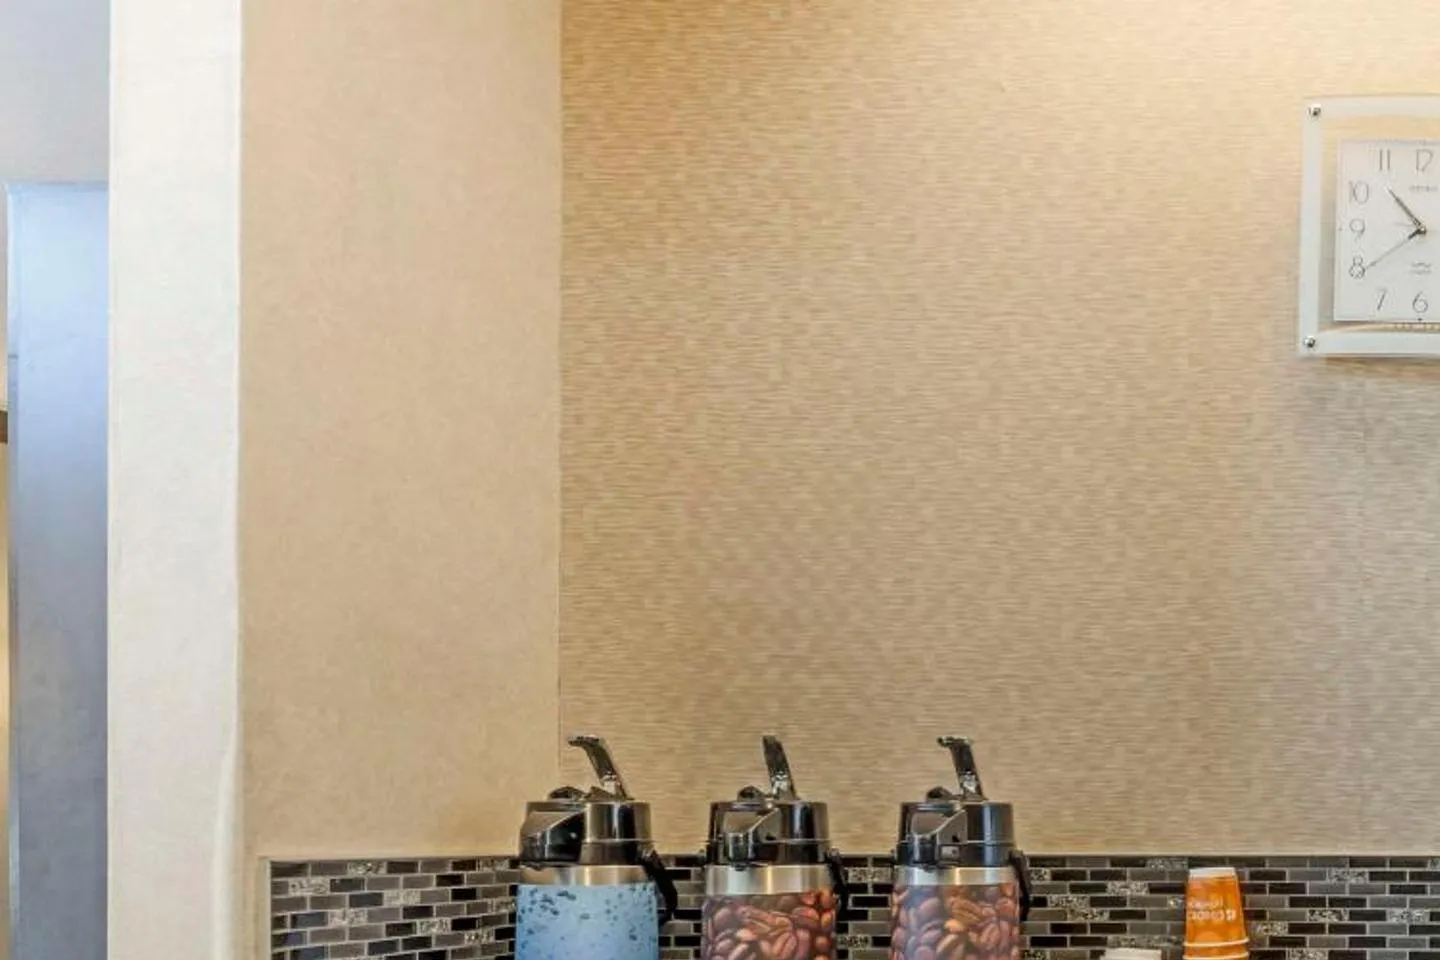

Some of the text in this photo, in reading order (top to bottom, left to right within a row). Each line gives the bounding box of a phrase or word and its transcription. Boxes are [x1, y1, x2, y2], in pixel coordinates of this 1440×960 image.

[1378, 149, 1391, 172] 11
[1415, 148, 1434, 173] 12
[1348, 180, 1370, 204] 10
[1348, 218, 1366, 242] 9
[1348, 254, 1366, 280] 8
[1373, 287, 1389, 311] 7
[1411, 291, 1429, 314] 6
